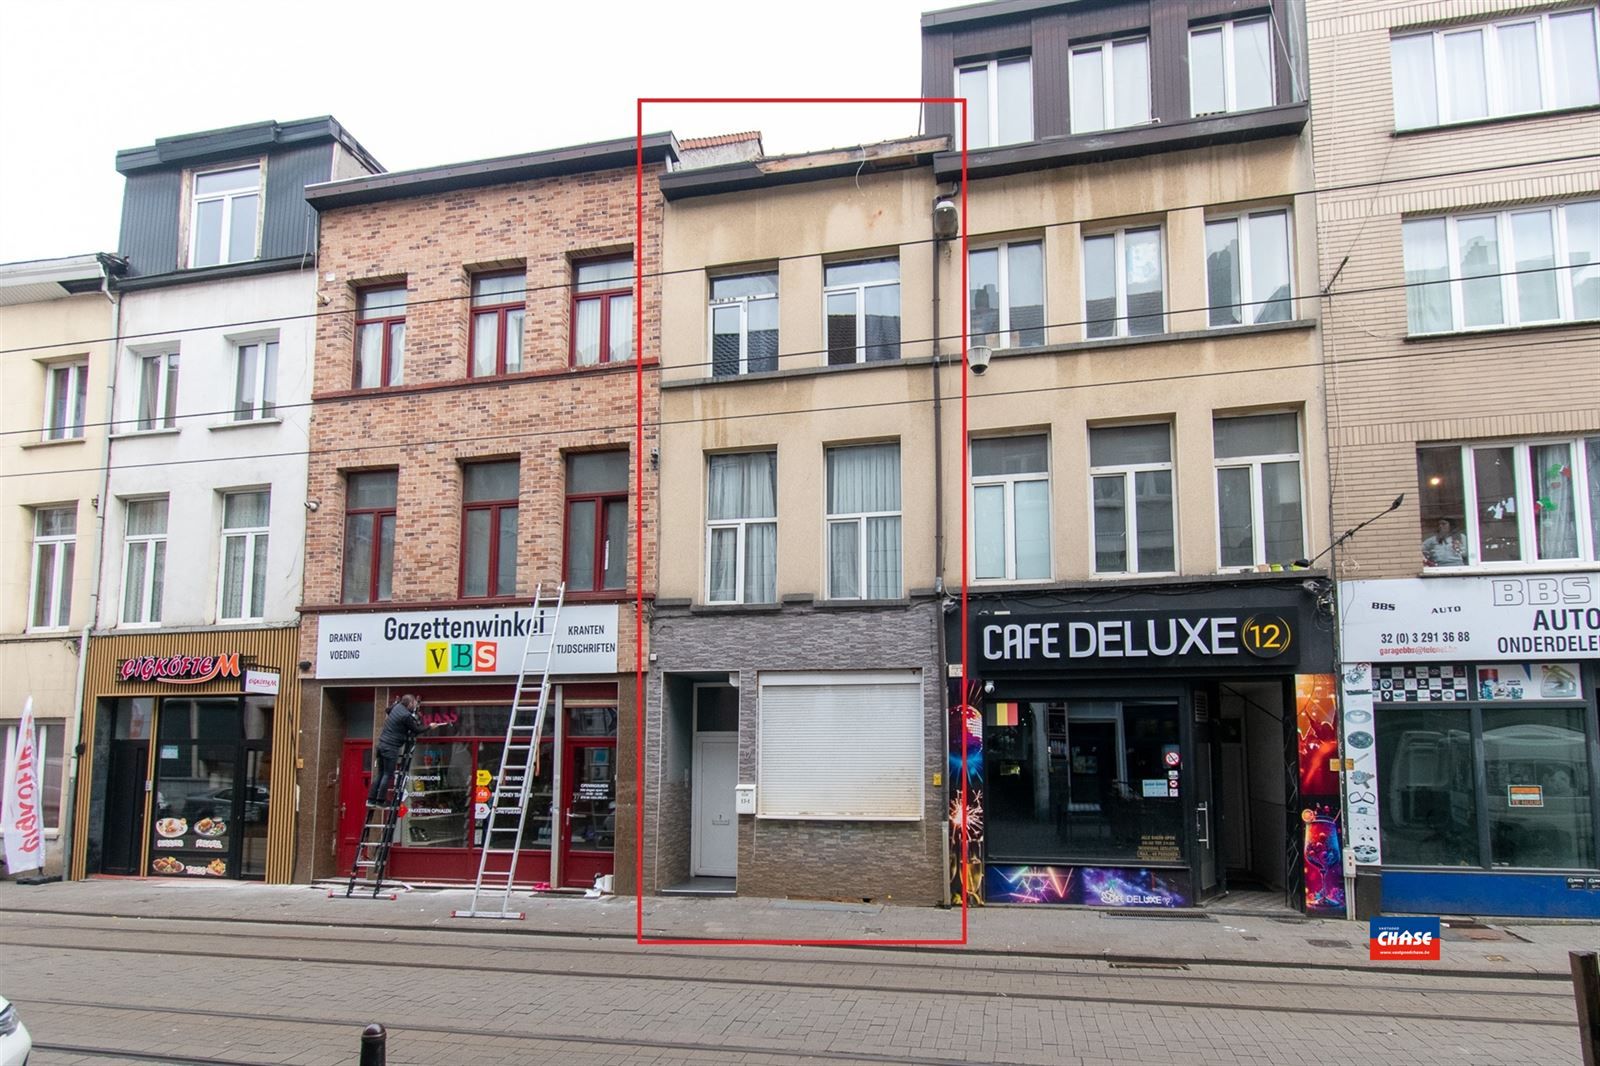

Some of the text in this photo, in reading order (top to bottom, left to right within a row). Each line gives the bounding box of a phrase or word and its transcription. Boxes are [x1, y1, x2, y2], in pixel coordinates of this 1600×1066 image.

[1492, 577, 1592, 607] BBS
[1371, 602, 1396, 612] BBS
[1431, 605, 1462, 615] AUTO
[1533, 608, 1600, 631] AUTO
[567, 625, 605, 636] KRANTEN
[329, 633, 362, 643] DRANKEN
[983, 617, 1281, 660] CAFE DELUXE 12
[1381, 631, 1470, 645] 32 (0) 3 291 36 88
[1497, 635, 1600, 653] ONDERDELE
[329, 650, 360, 660] VOEDING
[556, 642, 616, 655] TIJDSCHRIFTEN
[430, 643, 497, 670] VBS
